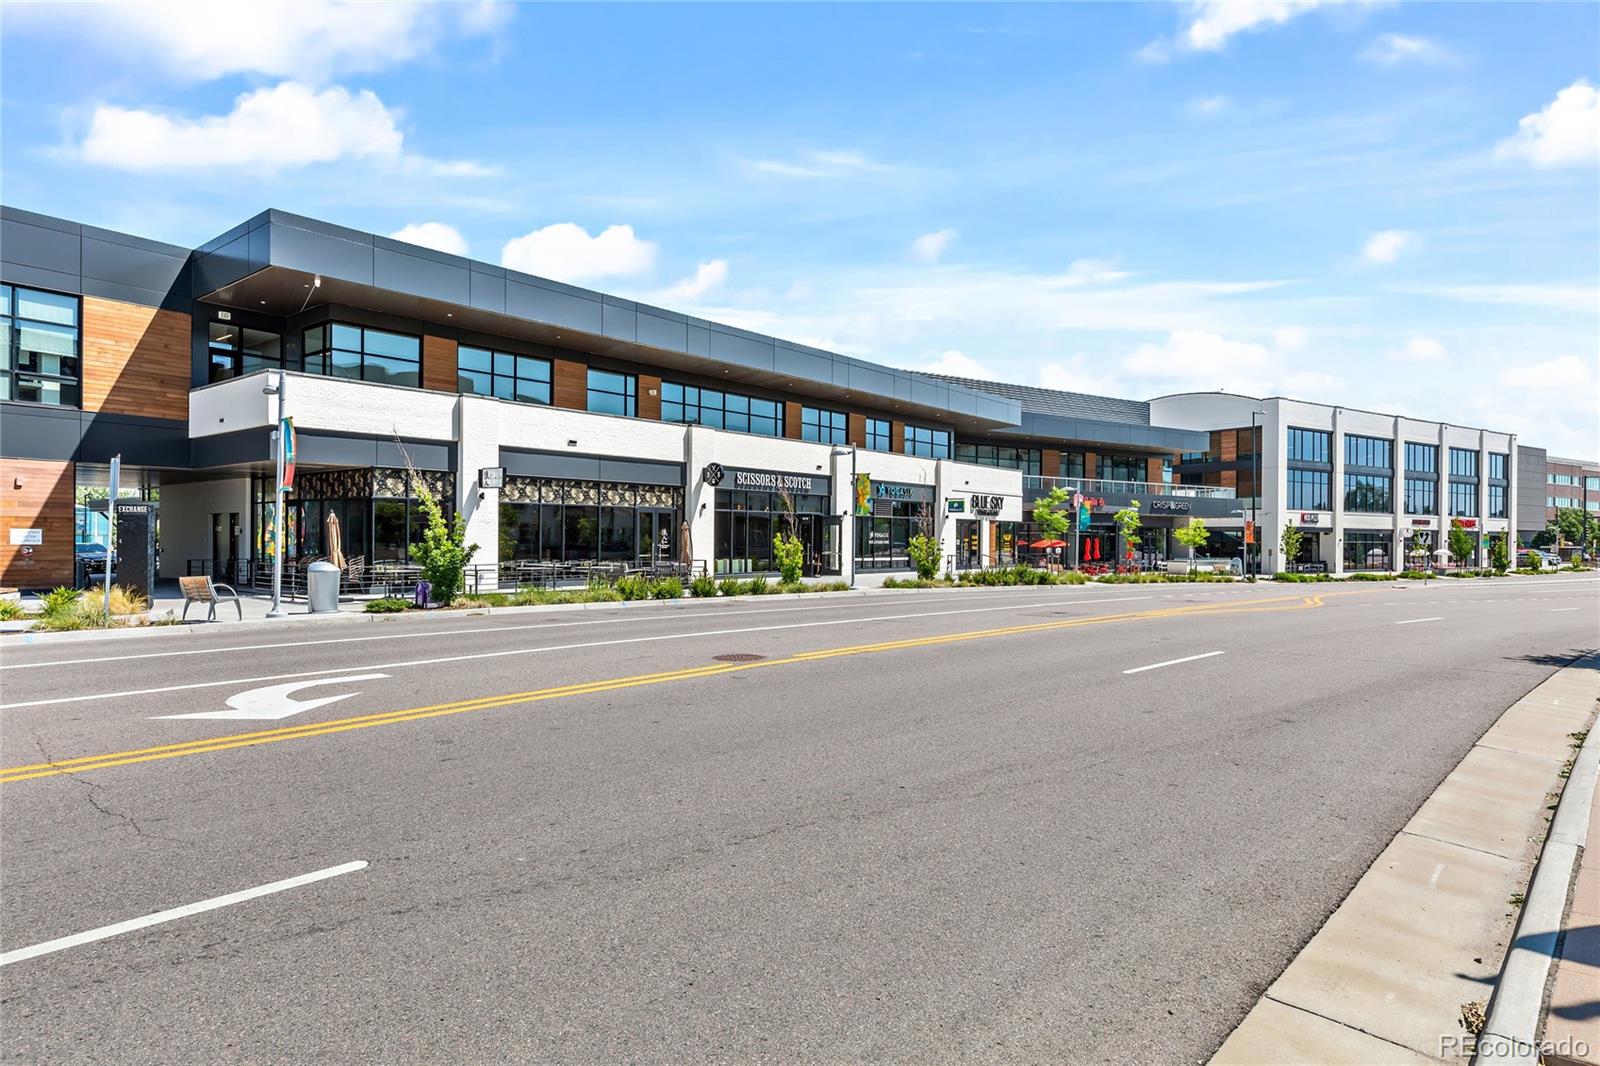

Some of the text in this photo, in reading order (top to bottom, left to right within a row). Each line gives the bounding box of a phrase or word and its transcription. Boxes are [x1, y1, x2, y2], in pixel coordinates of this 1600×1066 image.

[737, 472, 812, 489] SCISSORS & SCOTCH
[118, 505, 148, 513] EXCHANGE
[972, 495, 1004, 510] BLUE SKY
